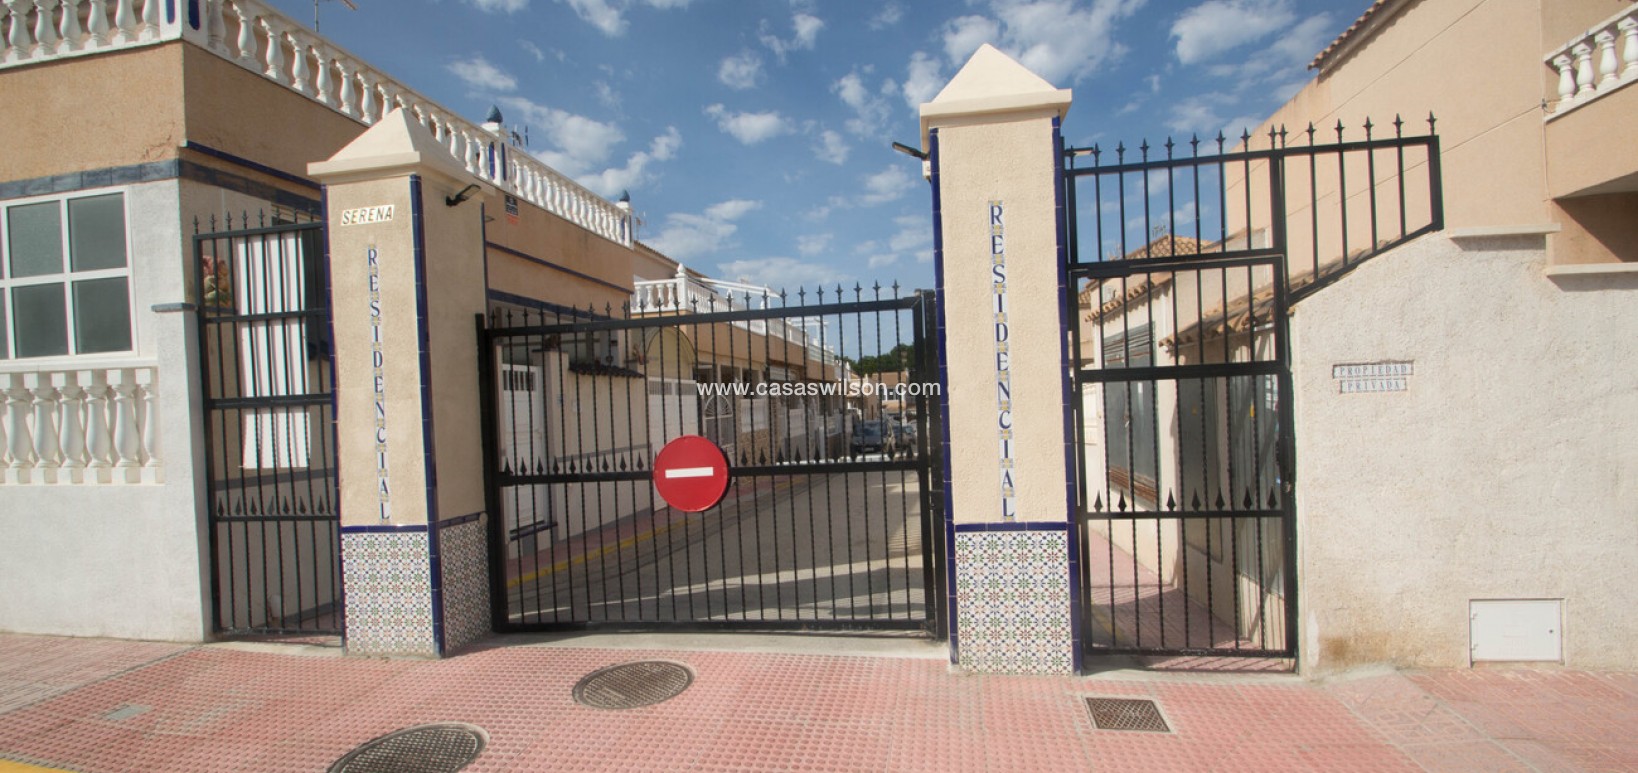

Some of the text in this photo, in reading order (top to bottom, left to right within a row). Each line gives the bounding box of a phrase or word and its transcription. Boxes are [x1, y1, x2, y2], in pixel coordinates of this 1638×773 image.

[342, 206, 393, 225] SERENA
[990, 204, 1014, 517] RESIDENCIAL
[1340, 364, 1407, 376] PROPIEDAD
[368, 248, 390, 520] RESIDENCIAL
[1347, 380, 1401, 391] PRIVADA
